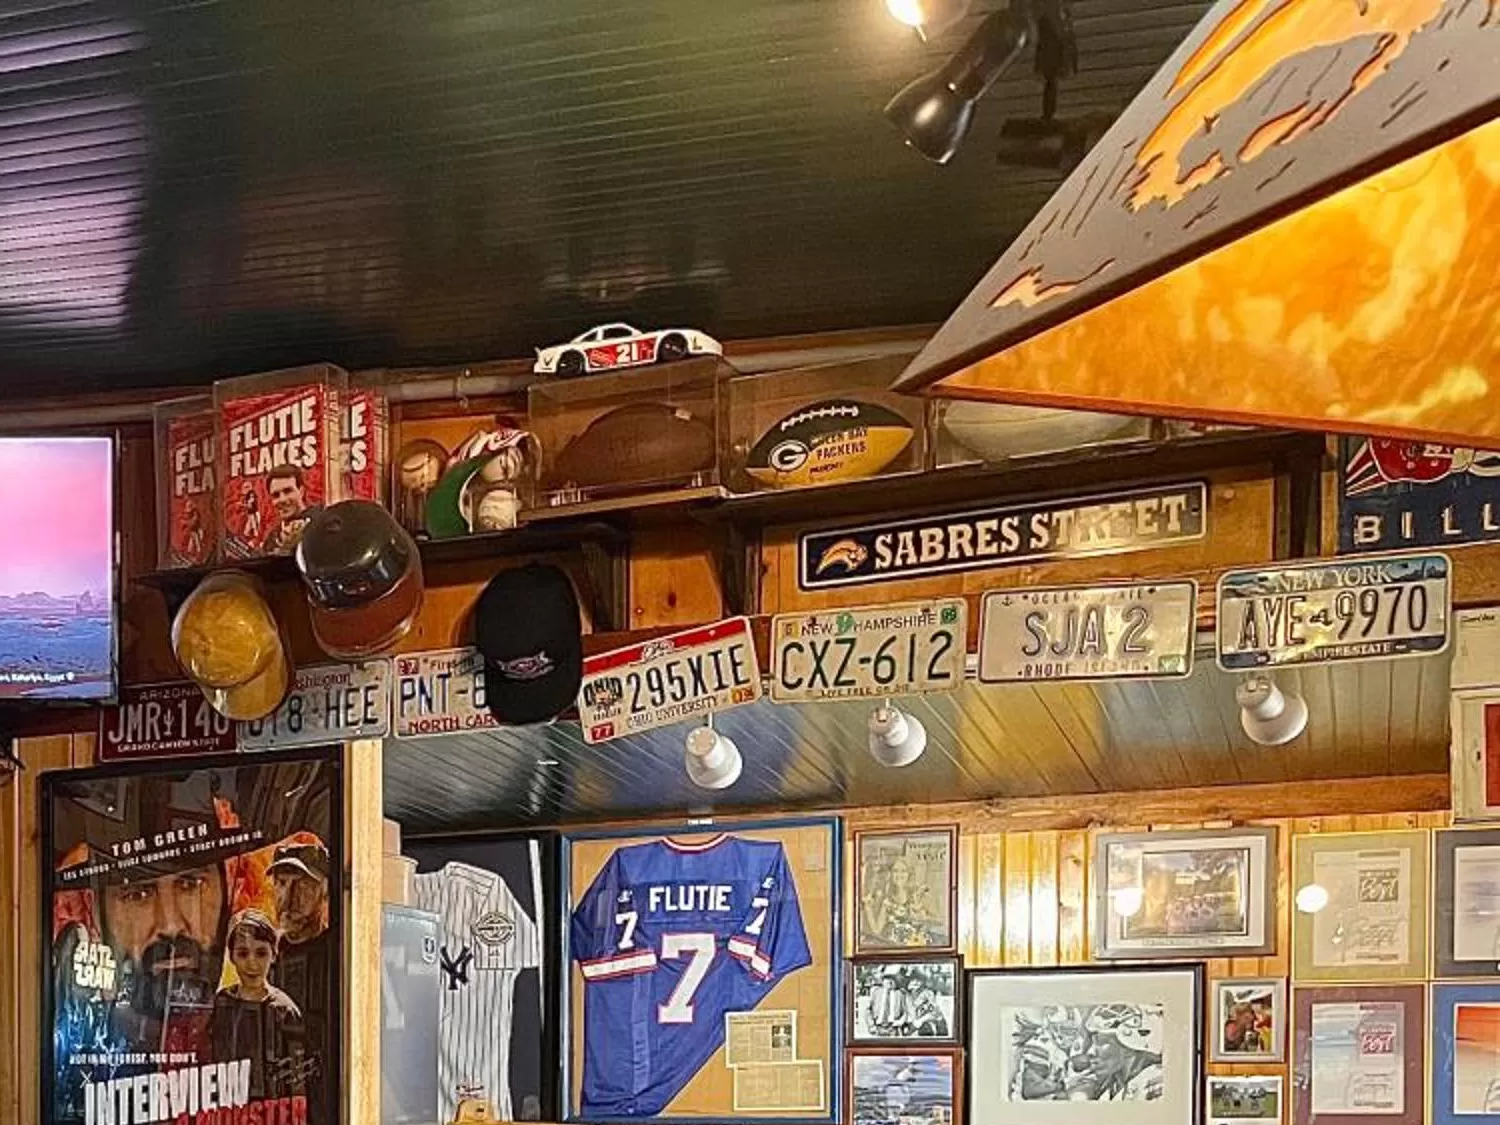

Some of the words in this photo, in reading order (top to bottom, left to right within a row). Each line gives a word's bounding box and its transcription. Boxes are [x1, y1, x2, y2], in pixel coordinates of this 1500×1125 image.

[615, 341, 639, 364] 21
[229, 395, 317, 454] FLUTIE
[175, 435, 216, 473] FLU
[230, 435, 317, 478] FLAKES
[815, 440, 868, 460] PACKERS
[175, 466, 215, 498] FLA
[873, 514, 1021, 570] SABRES
[1029, 495, 1188, 549] STREET
[1353, 502, 1500, 546] BILL
[1274, 569, 1326, 594] NEW
[1335, 562, 1393, 588] YORK
[801, 621, 834, 638] NEW
[853, 612, 938, 633] HAMPSHIRE
[1121, 604, 1151, 654] 2
[1238, 594, 1307, 651] AYE
[1335, 584, 1428, 642] 9970
[626, 643, 751, 715] 295XIE
[780, 629, 955, 691] CXZ-612
[408, 716, 460, 735] NORTH
[656, 695, 719, 721] UNIVERSITY
[111, 838, 147, 858] TOM
[154, 823, 209, 848] GREEN
[649, 884, 733, 912] FLUTIE
[615, 911, 639, 950] 7
[659, 931, 717, 1024] 7
